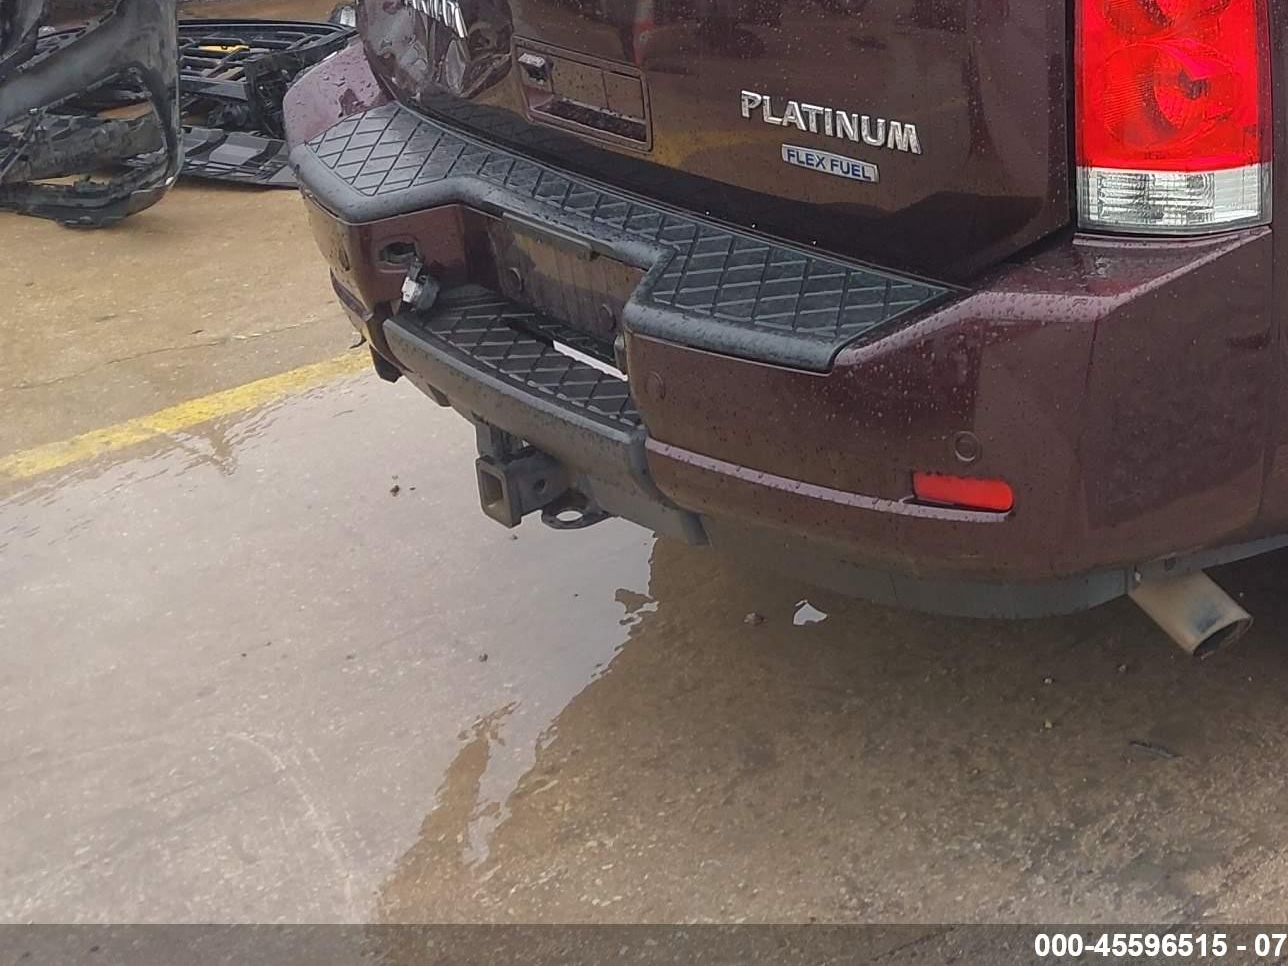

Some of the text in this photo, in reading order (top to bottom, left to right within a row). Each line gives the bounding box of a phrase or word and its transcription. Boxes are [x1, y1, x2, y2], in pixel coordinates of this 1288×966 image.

[741, 90, 922, 155] PLATINUM
[787, 148, 872, 180] FLEX FUEL
